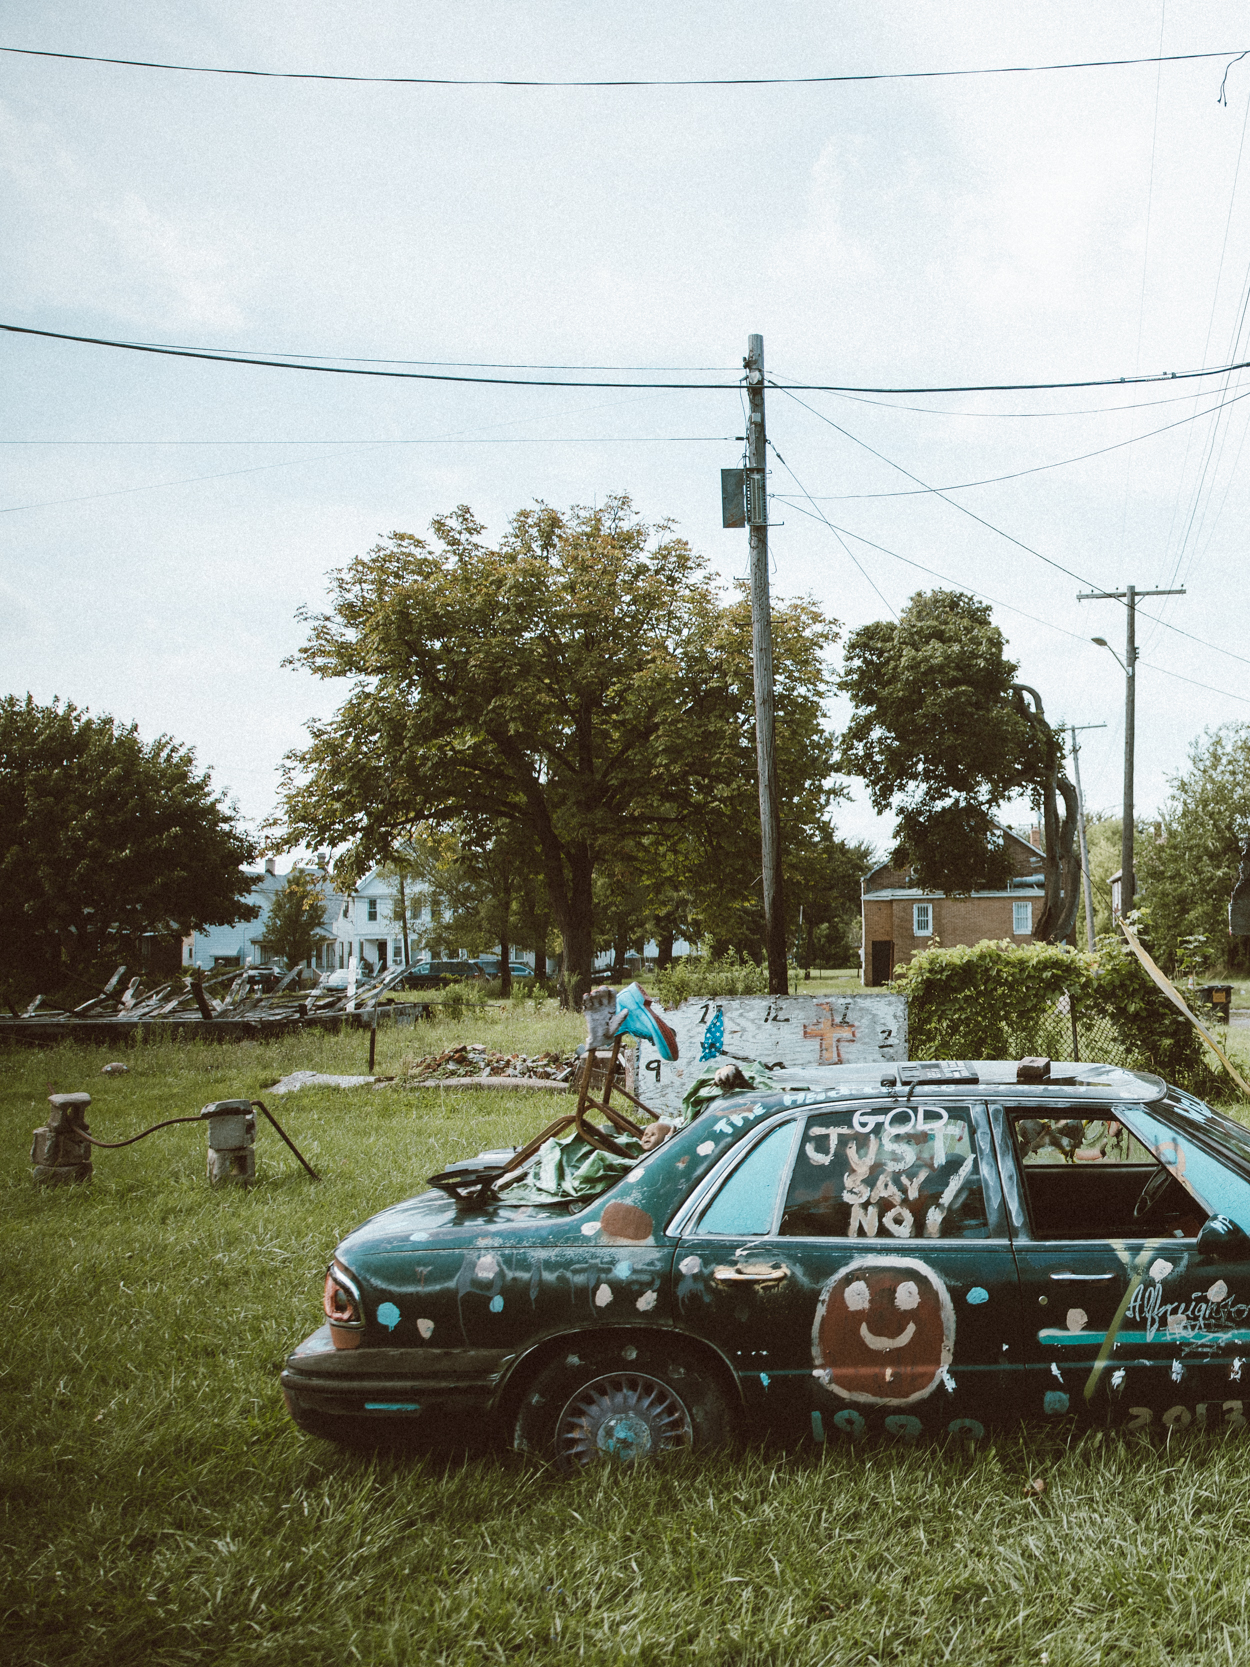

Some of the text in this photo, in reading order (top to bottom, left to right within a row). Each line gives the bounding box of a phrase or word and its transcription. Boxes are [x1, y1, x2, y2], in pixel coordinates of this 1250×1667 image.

[645, 1059, 662, 1083] 9
[853, 1106, 949, 1134] GOD
[805, 1124, 962, 1173] JUST
[842, 1168, 930, 1206] SAY
[1127, 1400, 1247, 1430] 2013
